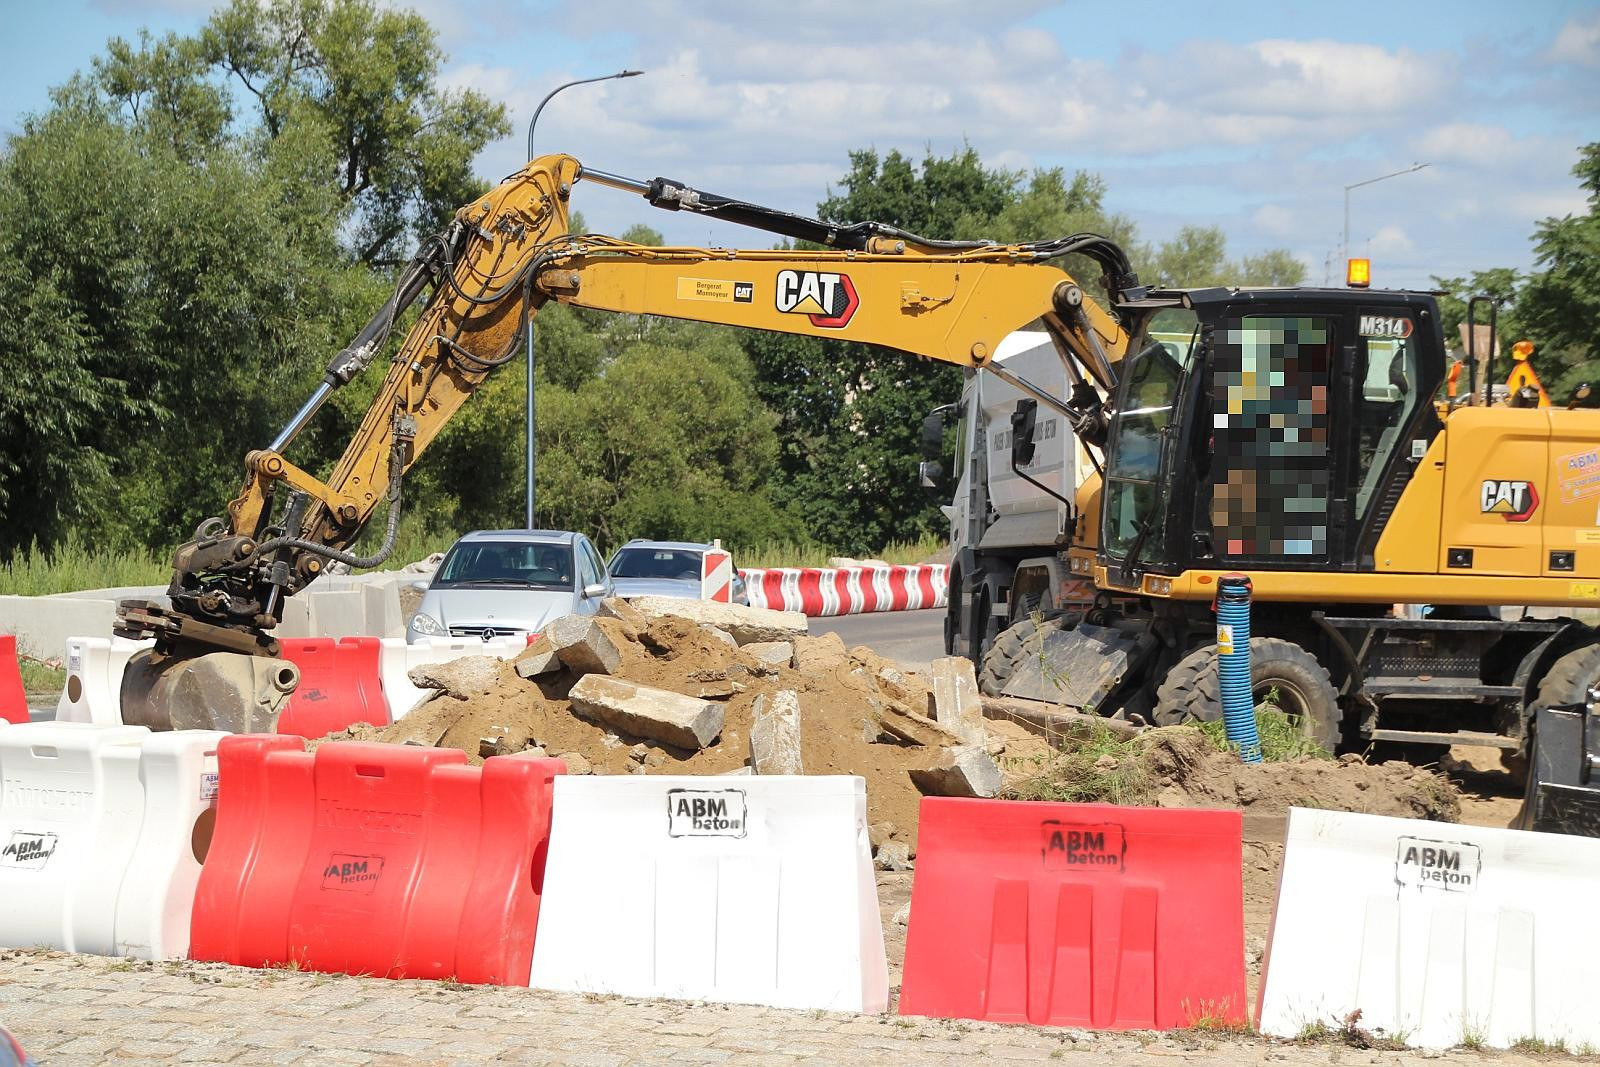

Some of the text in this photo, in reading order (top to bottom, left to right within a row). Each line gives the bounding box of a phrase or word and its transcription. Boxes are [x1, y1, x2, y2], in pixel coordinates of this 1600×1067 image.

[695, 289, 729, 299] Monnoyeur
[696, 281, 722, 290] Bergerat
[736, 286, 752, 298] CAT
[777, 270, 840, 315] CAT
[1360, 316, 1403, 336] M314
[1481, 480, 1527, 513] CAT
[676, 798, 728, 817] ABM
[692, 816, 742, 830] beton
[5, 838, 43, 856] ABM
[1048, 830, 1105, 852] ABM
[15, 850, 50, 862] beton
[1066, 850, 1118, 865] beton
[1403, 846, 1460, 871] ABM
[327, 861, 368, 878] ABM
[341, 872, 377, 884] beton
[1420, 867, 1471, 885] beton
